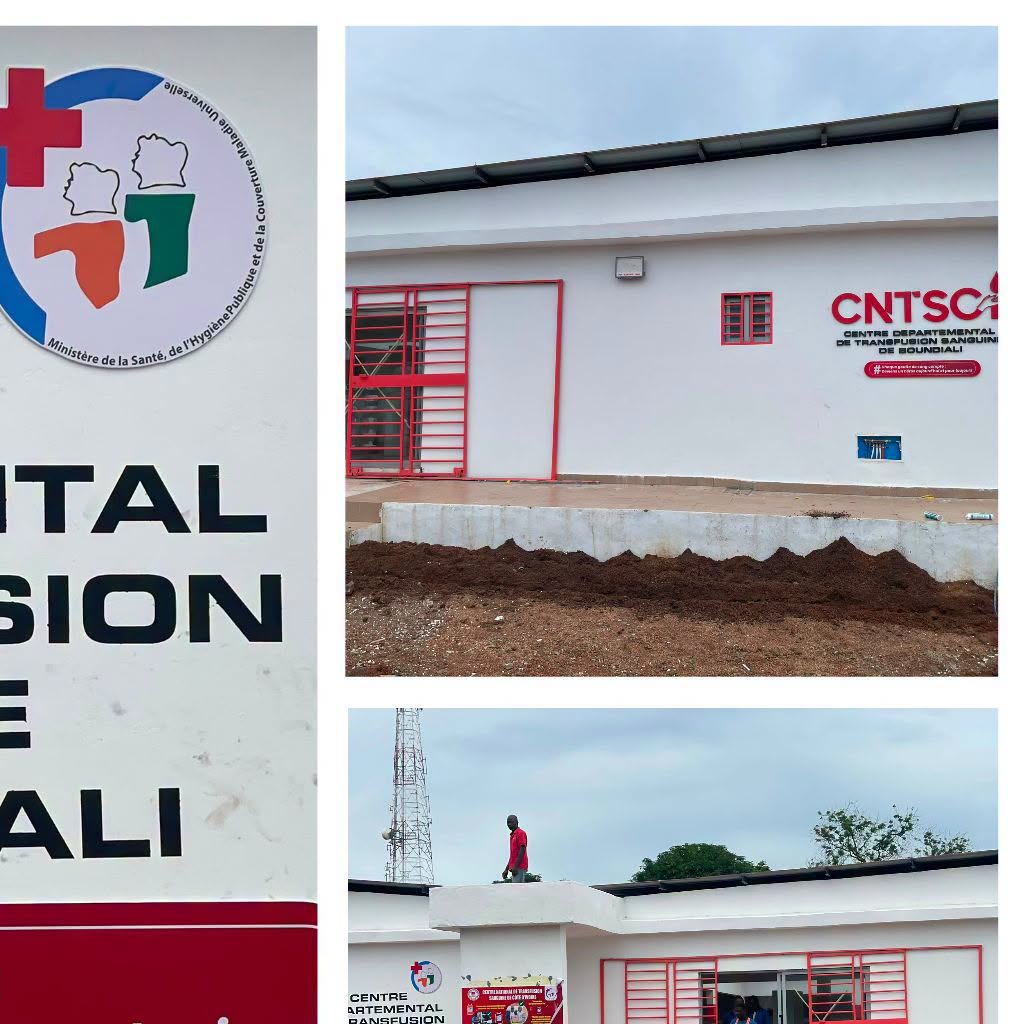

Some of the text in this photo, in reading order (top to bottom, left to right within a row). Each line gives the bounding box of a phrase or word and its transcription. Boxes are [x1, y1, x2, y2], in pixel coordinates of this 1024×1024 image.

[164, 81, 219, 122] Universelle
[219, 119, 249, 159] Maladie
[245, 159, 266, 222] Couverture
[255, 225, 265, 235] la
[254, 237, 265, 252] de
[252, 254, 261, 267] et
[844, 330, 888, 338] CENTRE
[836, 336, 998, 347] DE TRANSFUSION SANGUIN
[48, 338, 99, 363] Ministère
[169, 346, 183, 357] de
[879, 345, 963, 355] DE BOUNDIALI
[102, 355, 115, 365] de
[118, 356, 128, 366] la
[131, 351, 167, 366] Santé,
[349, 992, 408, 1002] CENTRE
